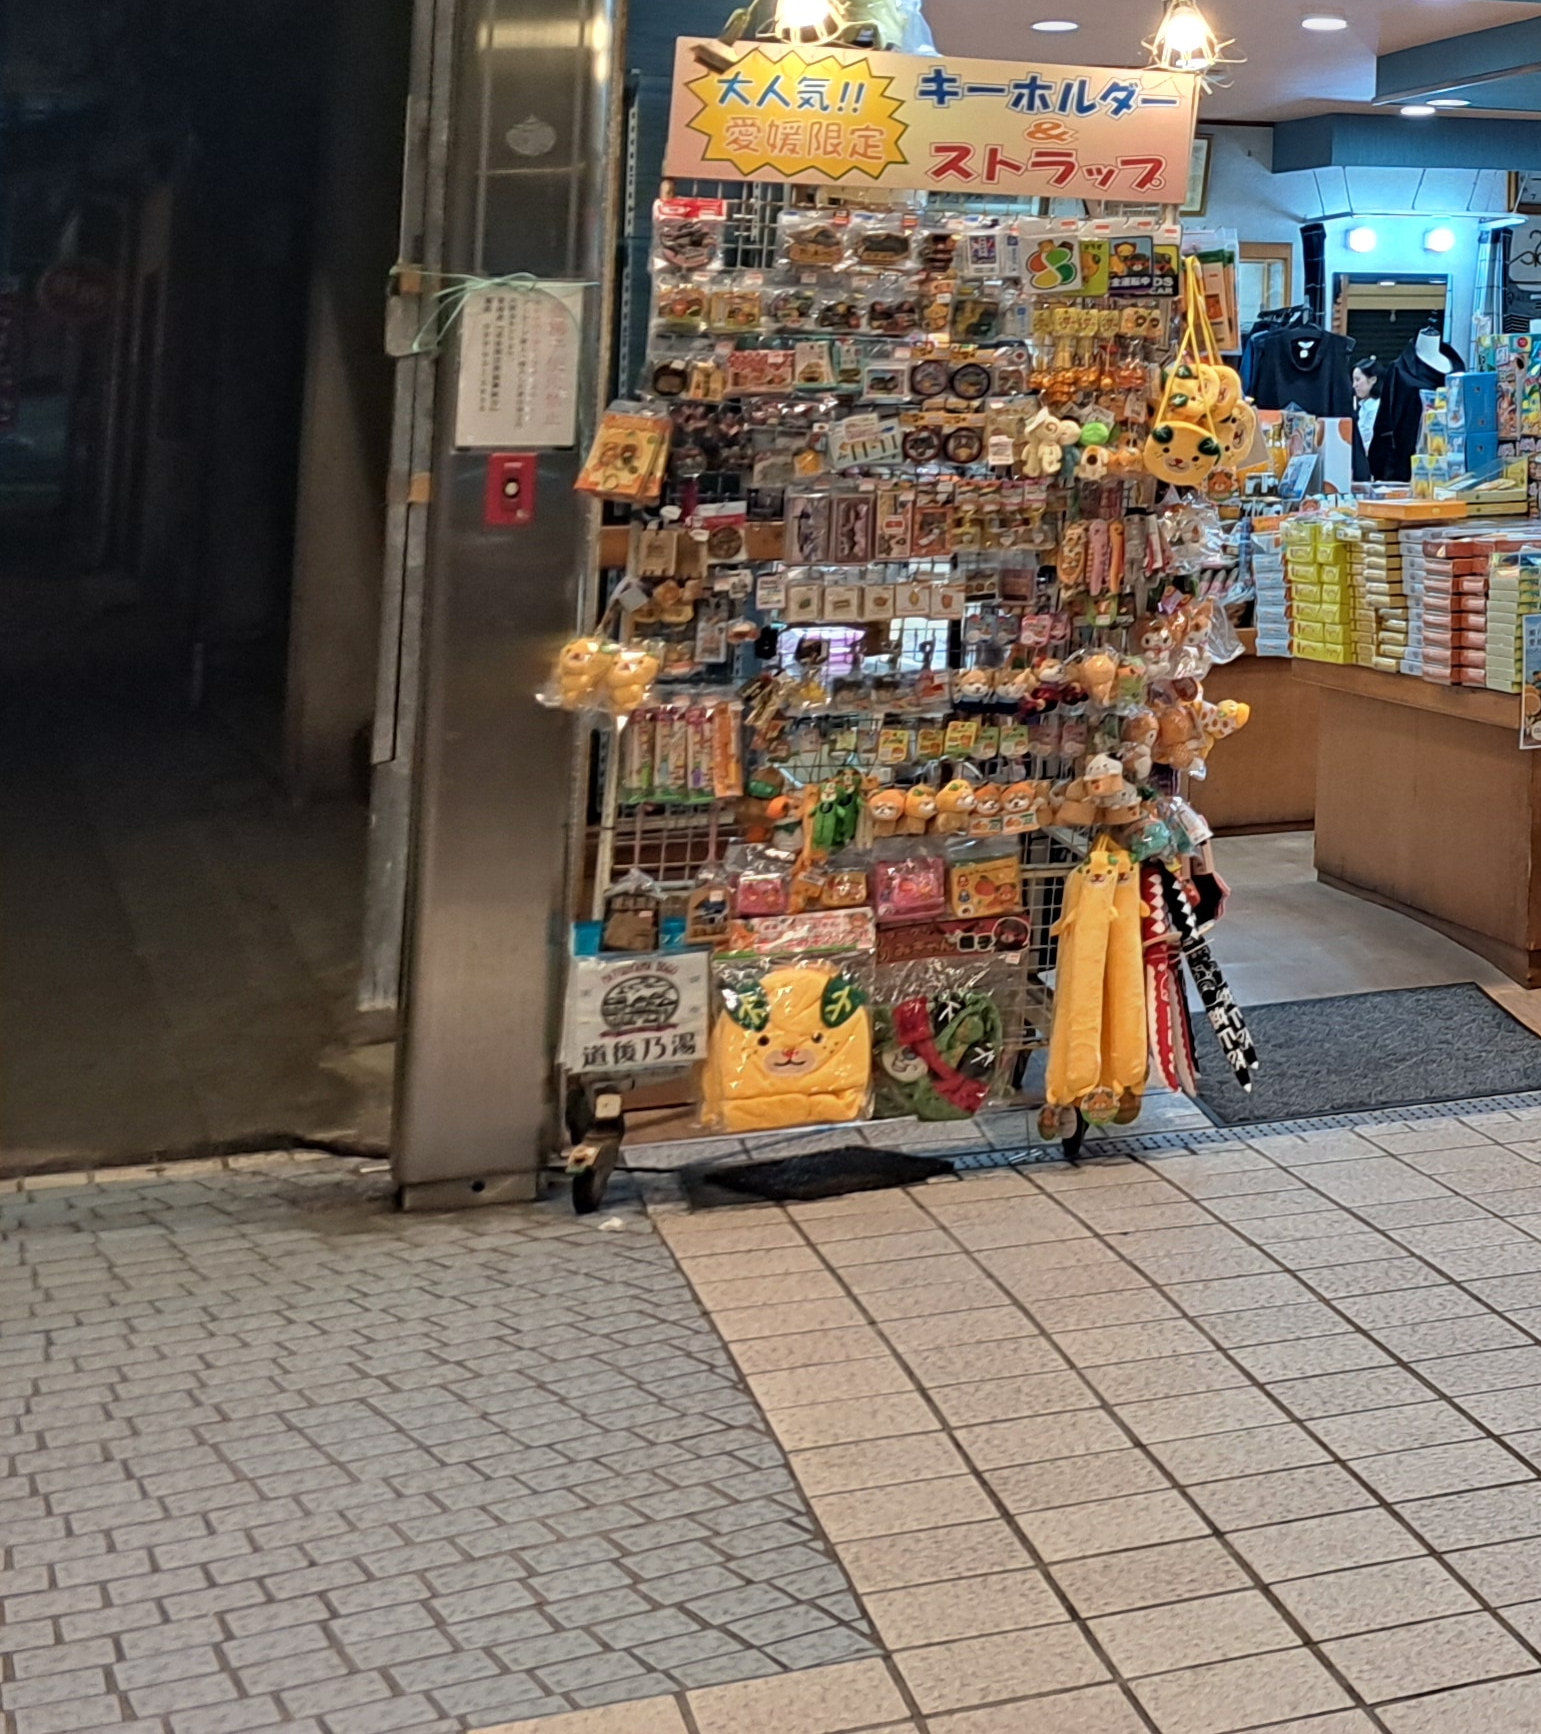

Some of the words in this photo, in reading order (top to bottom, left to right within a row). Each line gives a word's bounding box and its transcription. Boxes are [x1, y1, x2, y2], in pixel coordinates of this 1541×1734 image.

[916, 66, 1180, 119] キーホルダー
[726, 116, 885, 161] 愛媛限定
[1024, 118, 1078, 144] &
[926, 142, 1166, 193] ストラップ
[1153, 276, 1174, 287] DS
[582, 1032, 696, 1067] 道後乃湯
